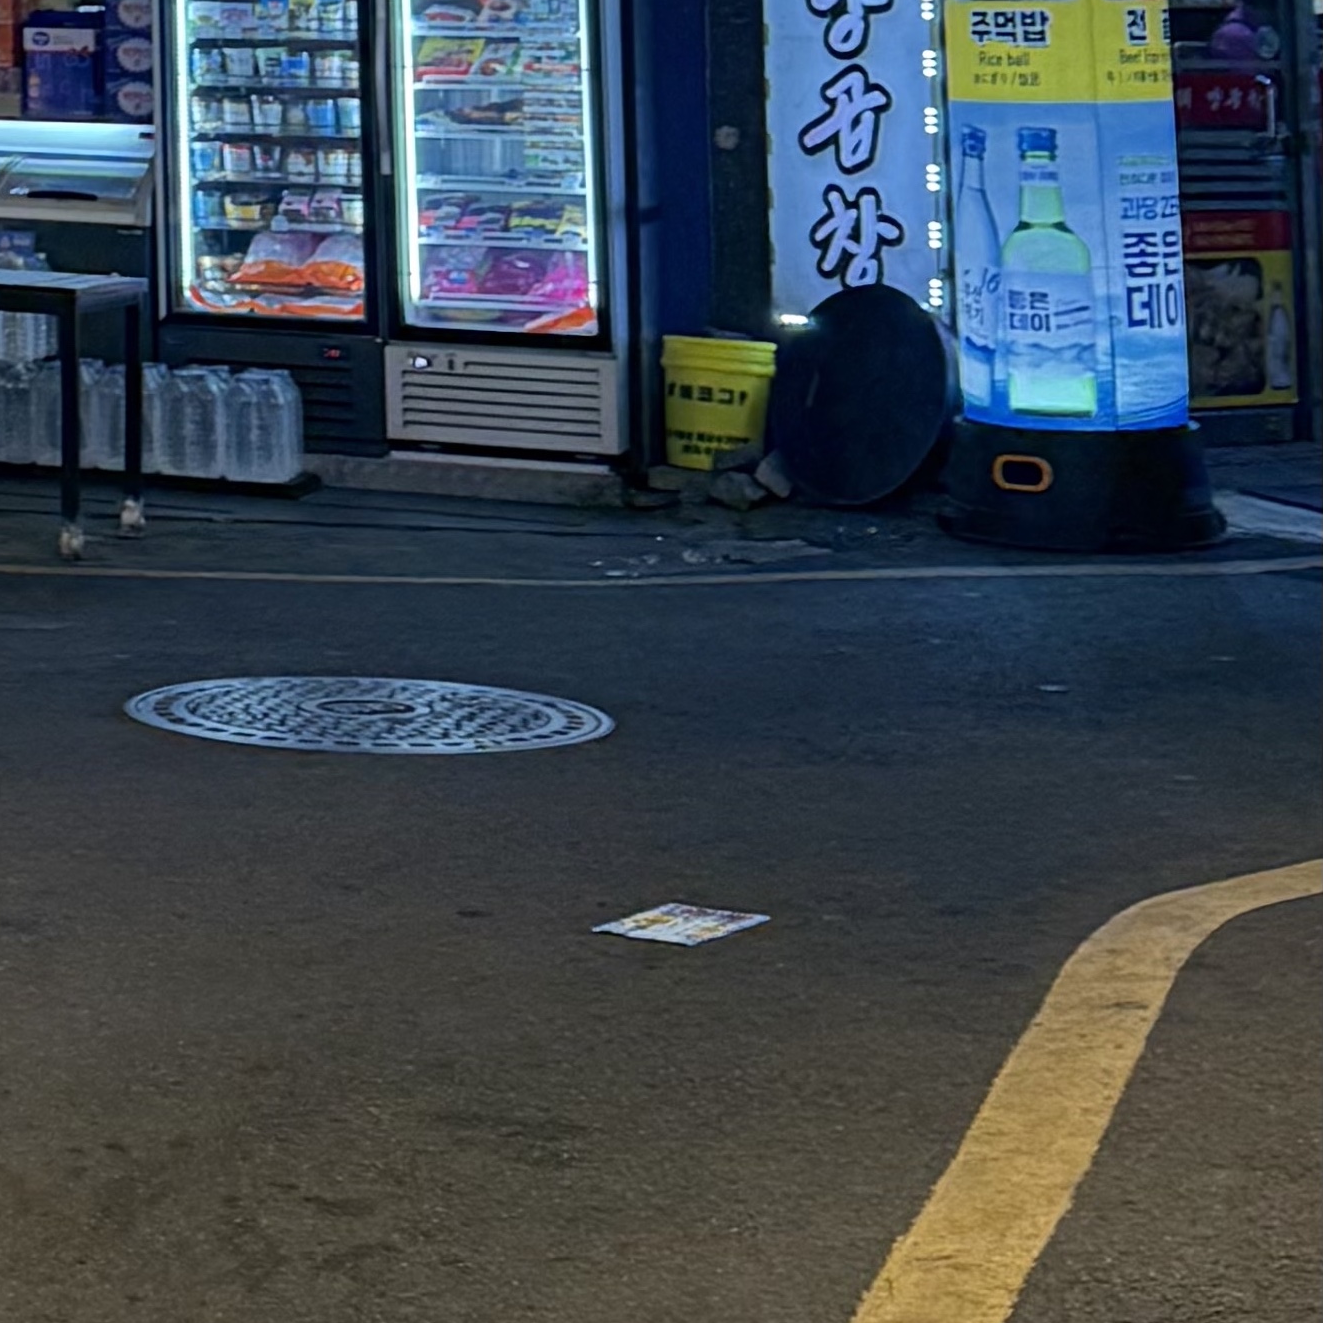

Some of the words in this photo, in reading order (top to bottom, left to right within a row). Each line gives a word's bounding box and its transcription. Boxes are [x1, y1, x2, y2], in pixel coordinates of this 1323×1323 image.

[969, 8, 1053, 48] 주먹밥
[978, 50, 1003, 67] Rice
[1005, 50, 1031, 66] ball
[1009, 312, 1052, 333] 데이
